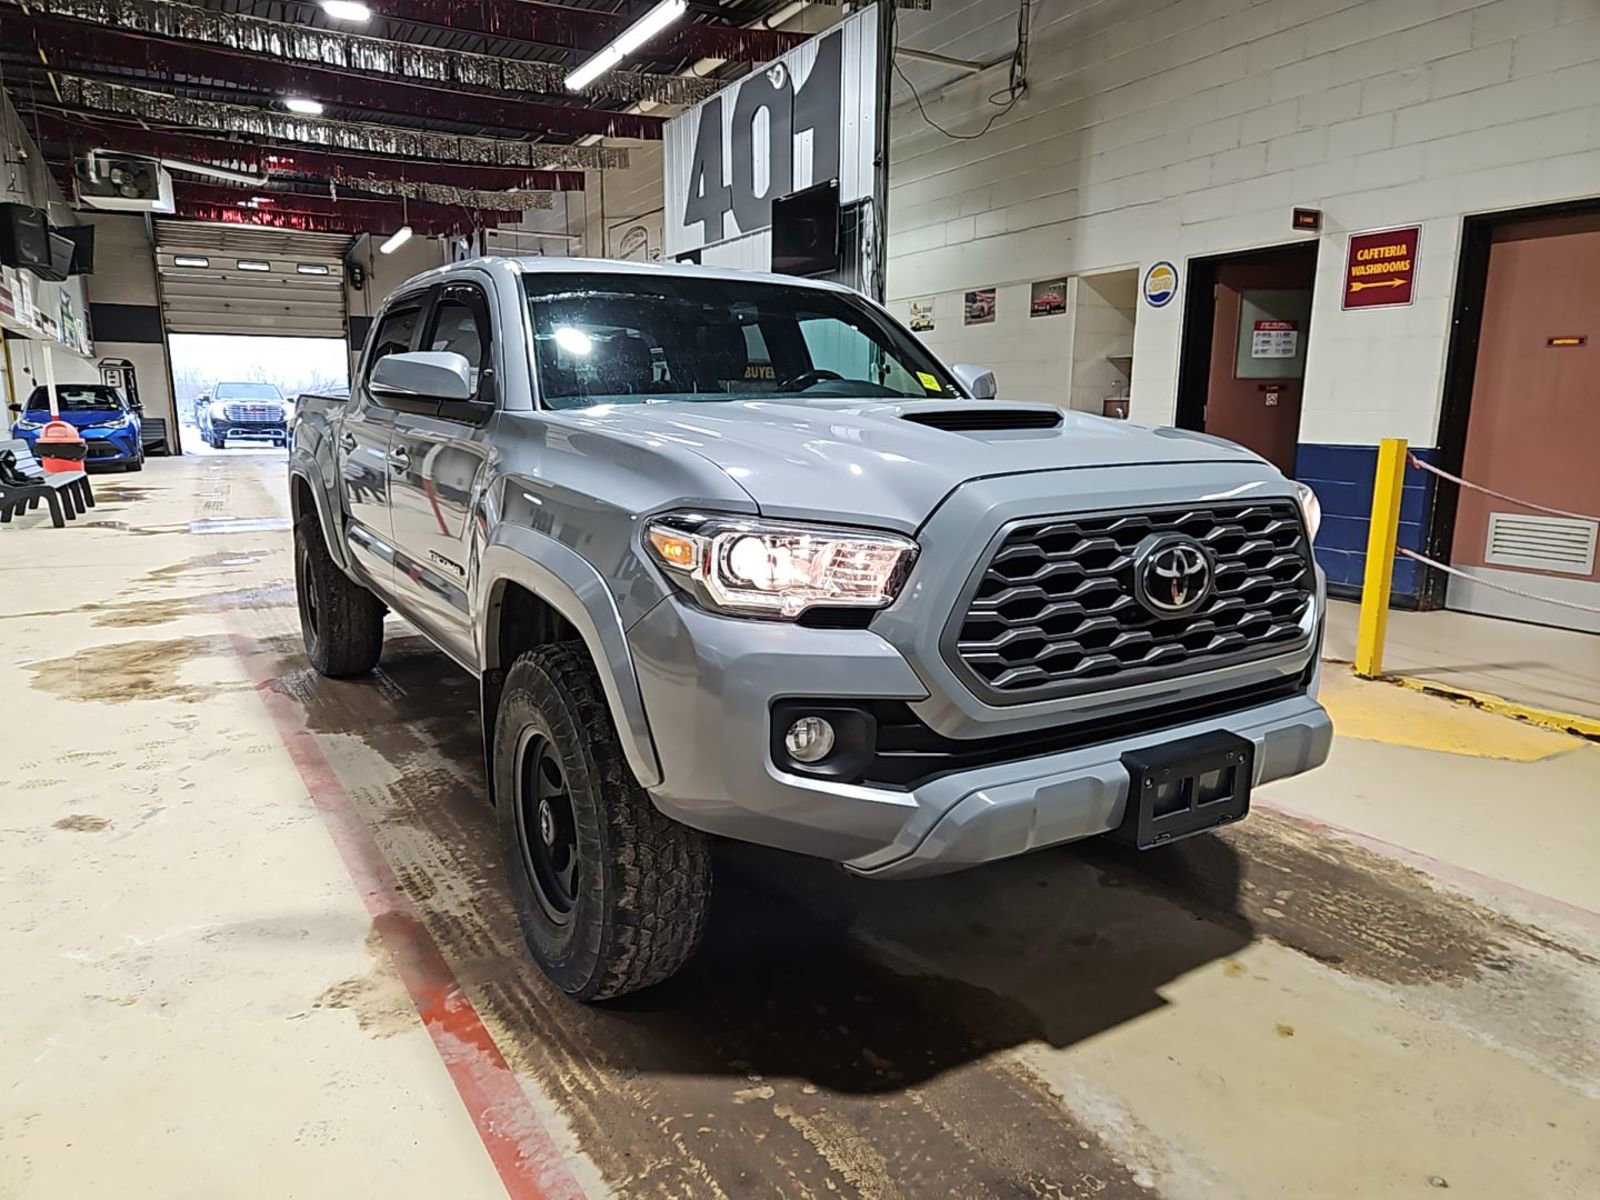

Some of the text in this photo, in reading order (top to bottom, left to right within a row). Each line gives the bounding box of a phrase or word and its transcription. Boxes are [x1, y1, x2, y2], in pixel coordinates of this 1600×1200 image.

[683, 28, 842, 245] 401
[1356, 244, 1407, 261] CAFETERIA
[1351, 260, 1411, 276] WASHROOMS
